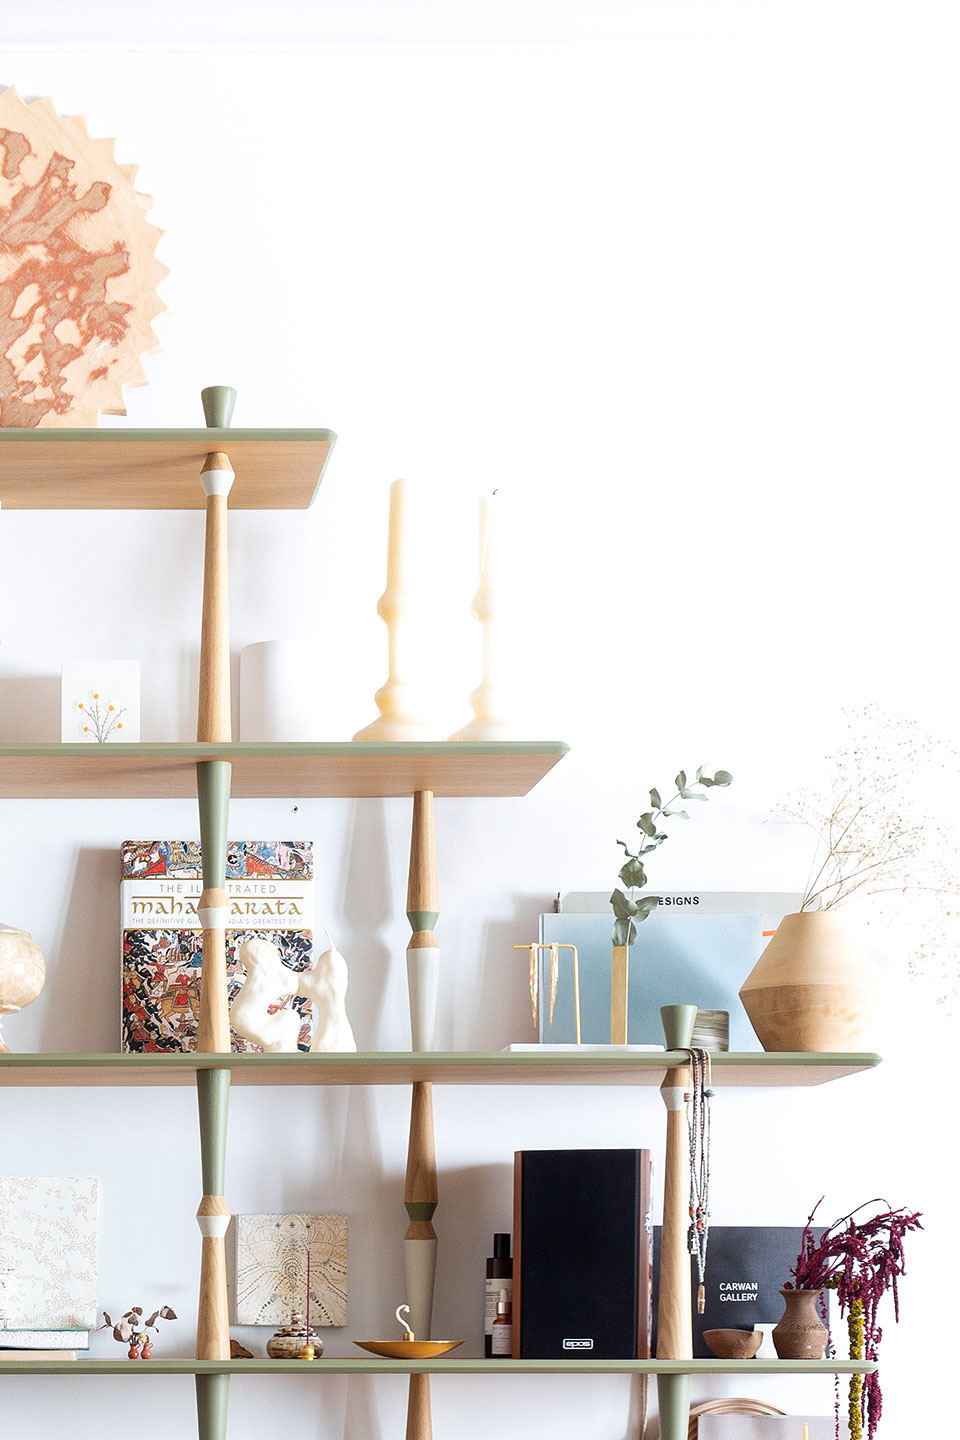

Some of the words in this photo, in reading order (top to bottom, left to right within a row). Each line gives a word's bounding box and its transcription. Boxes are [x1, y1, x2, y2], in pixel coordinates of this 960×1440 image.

[159, 884, 183, 894] THE
[191, 884, 277, 894] ILTRATED
[658, 896, 700, 906] ESIGNS
[719, 1282, 758, 1292] CARWAN
[719, 1293, 758, 1302] GALLERY
[565, 1340, 591, 1348] epos
